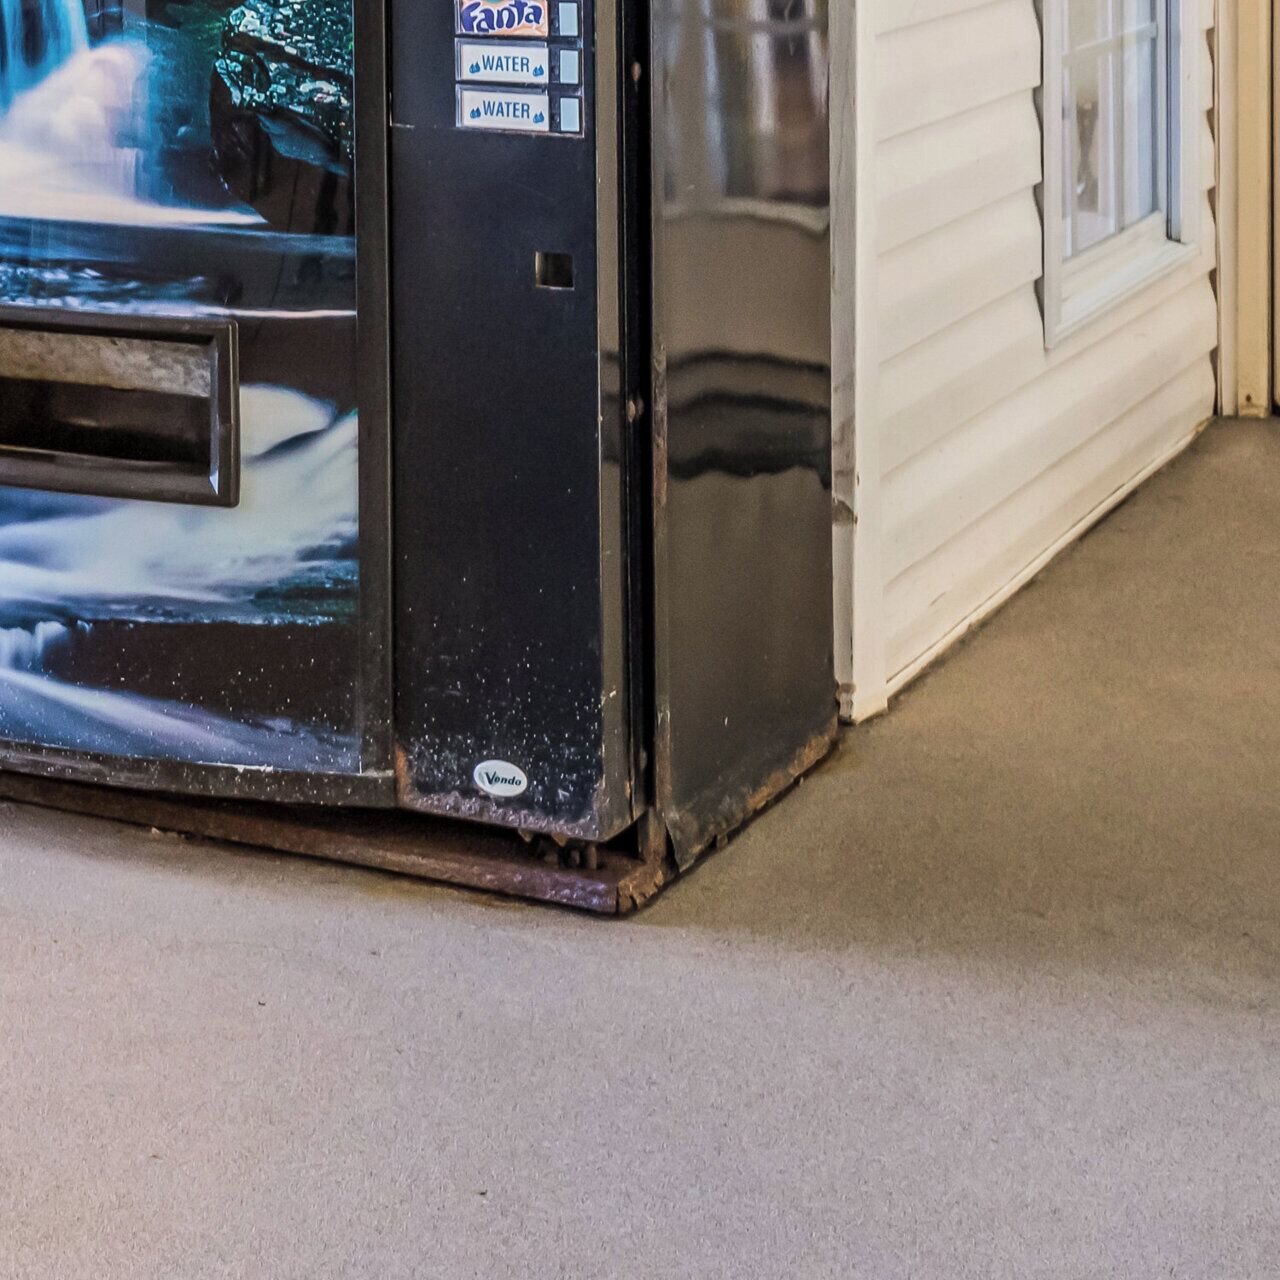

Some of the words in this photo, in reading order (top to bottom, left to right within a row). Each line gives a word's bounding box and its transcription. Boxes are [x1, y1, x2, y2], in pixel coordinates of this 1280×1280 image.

[461, 0, 542, 33] Fanta
[482, 55, 529, 73] WATER
[483, 100, 530, 119] WATER
[484, 770, 522, 786] Vendo
